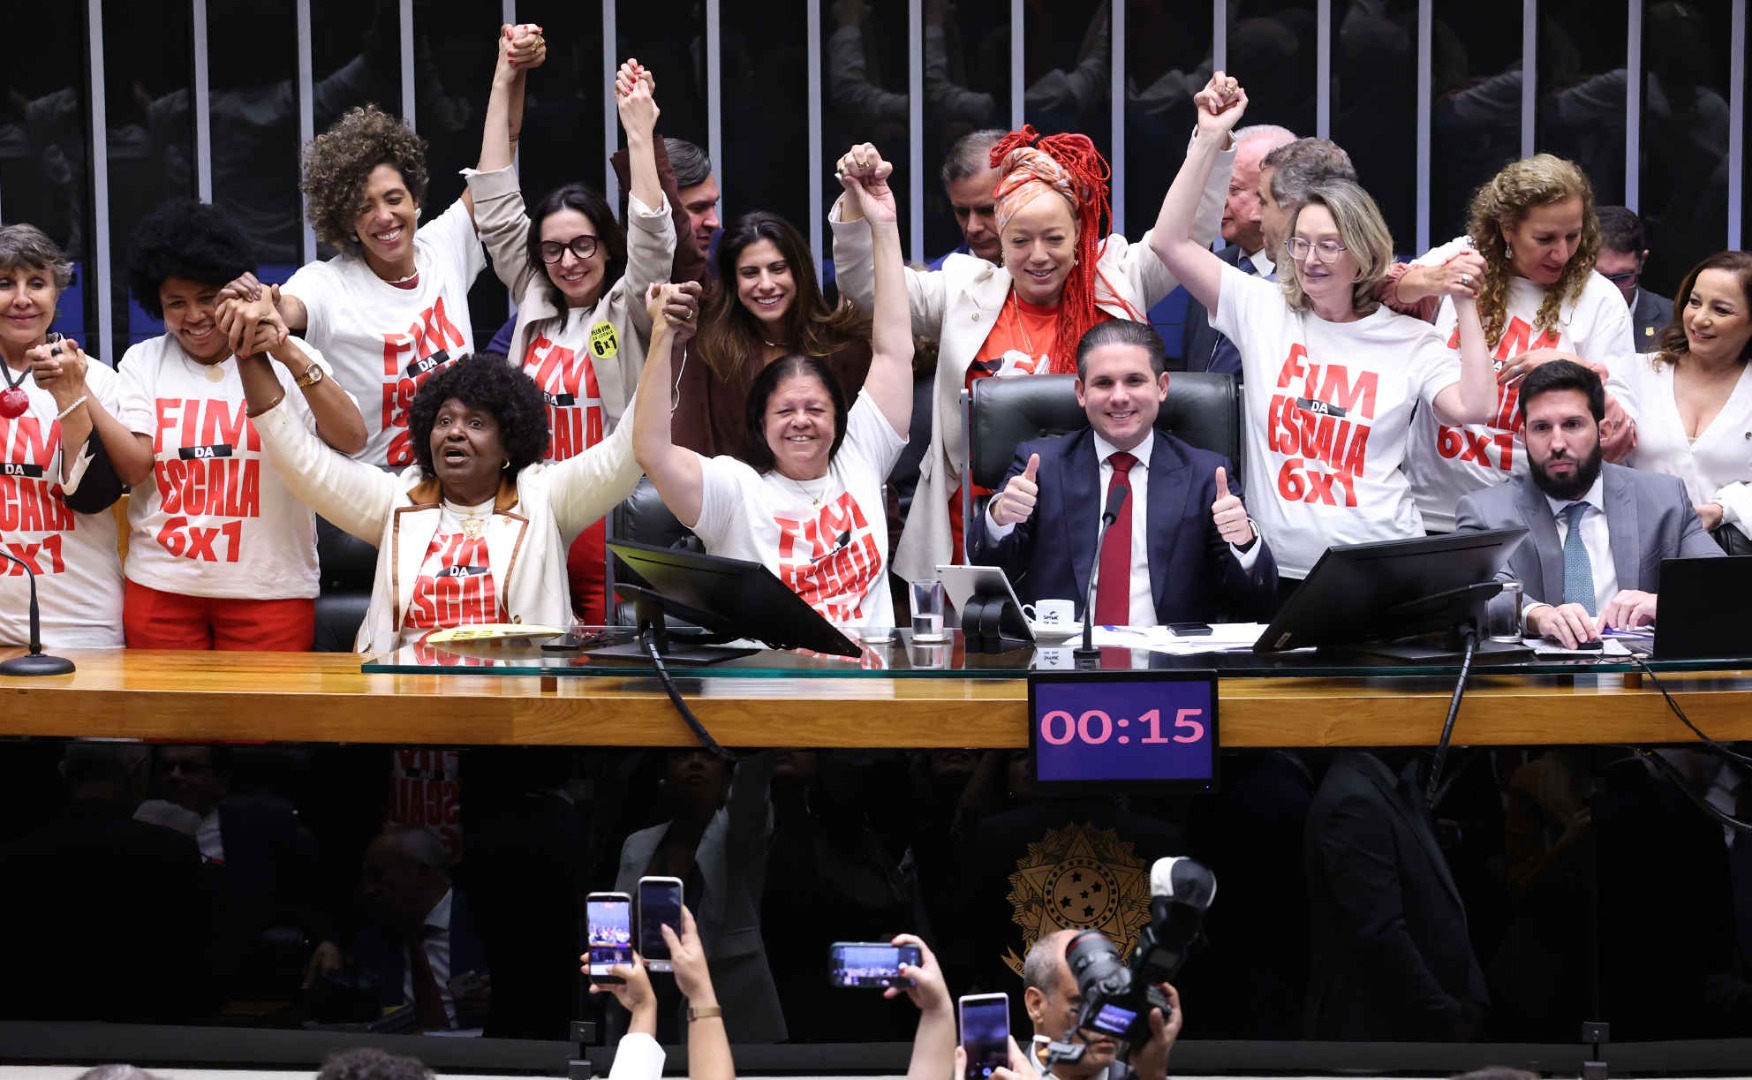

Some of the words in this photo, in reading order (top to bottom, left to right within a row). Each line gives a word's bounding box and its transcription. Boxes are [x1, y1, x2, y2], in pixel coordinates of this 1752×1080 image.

[383, 296, 465, 376] FIM
[418, 357, 437, 372] DA
[522, 331, 601, 399] FIM
[1277, 342, 1379, 420] FIM
[154, 397, 261, 454] FIM
[1311, 402, 1329, 414] DA
[0, 416, 63, 471] IM
[194, 446, 215, 459] DA
[1267, 394, 1371, 478] ESCALA
[5, 463, 25, 476] DA
[155, 459, 260, 518] ESCALA
[0, 474, 75, 532] CALA
[774, 491, 868, 558] FIM
[0, 532, 65, 577] x1
[450, 565, 470, 577] DA
[403, 574, 508, 629] SCAL
[1040, 708, 1205, 745] 00:15
